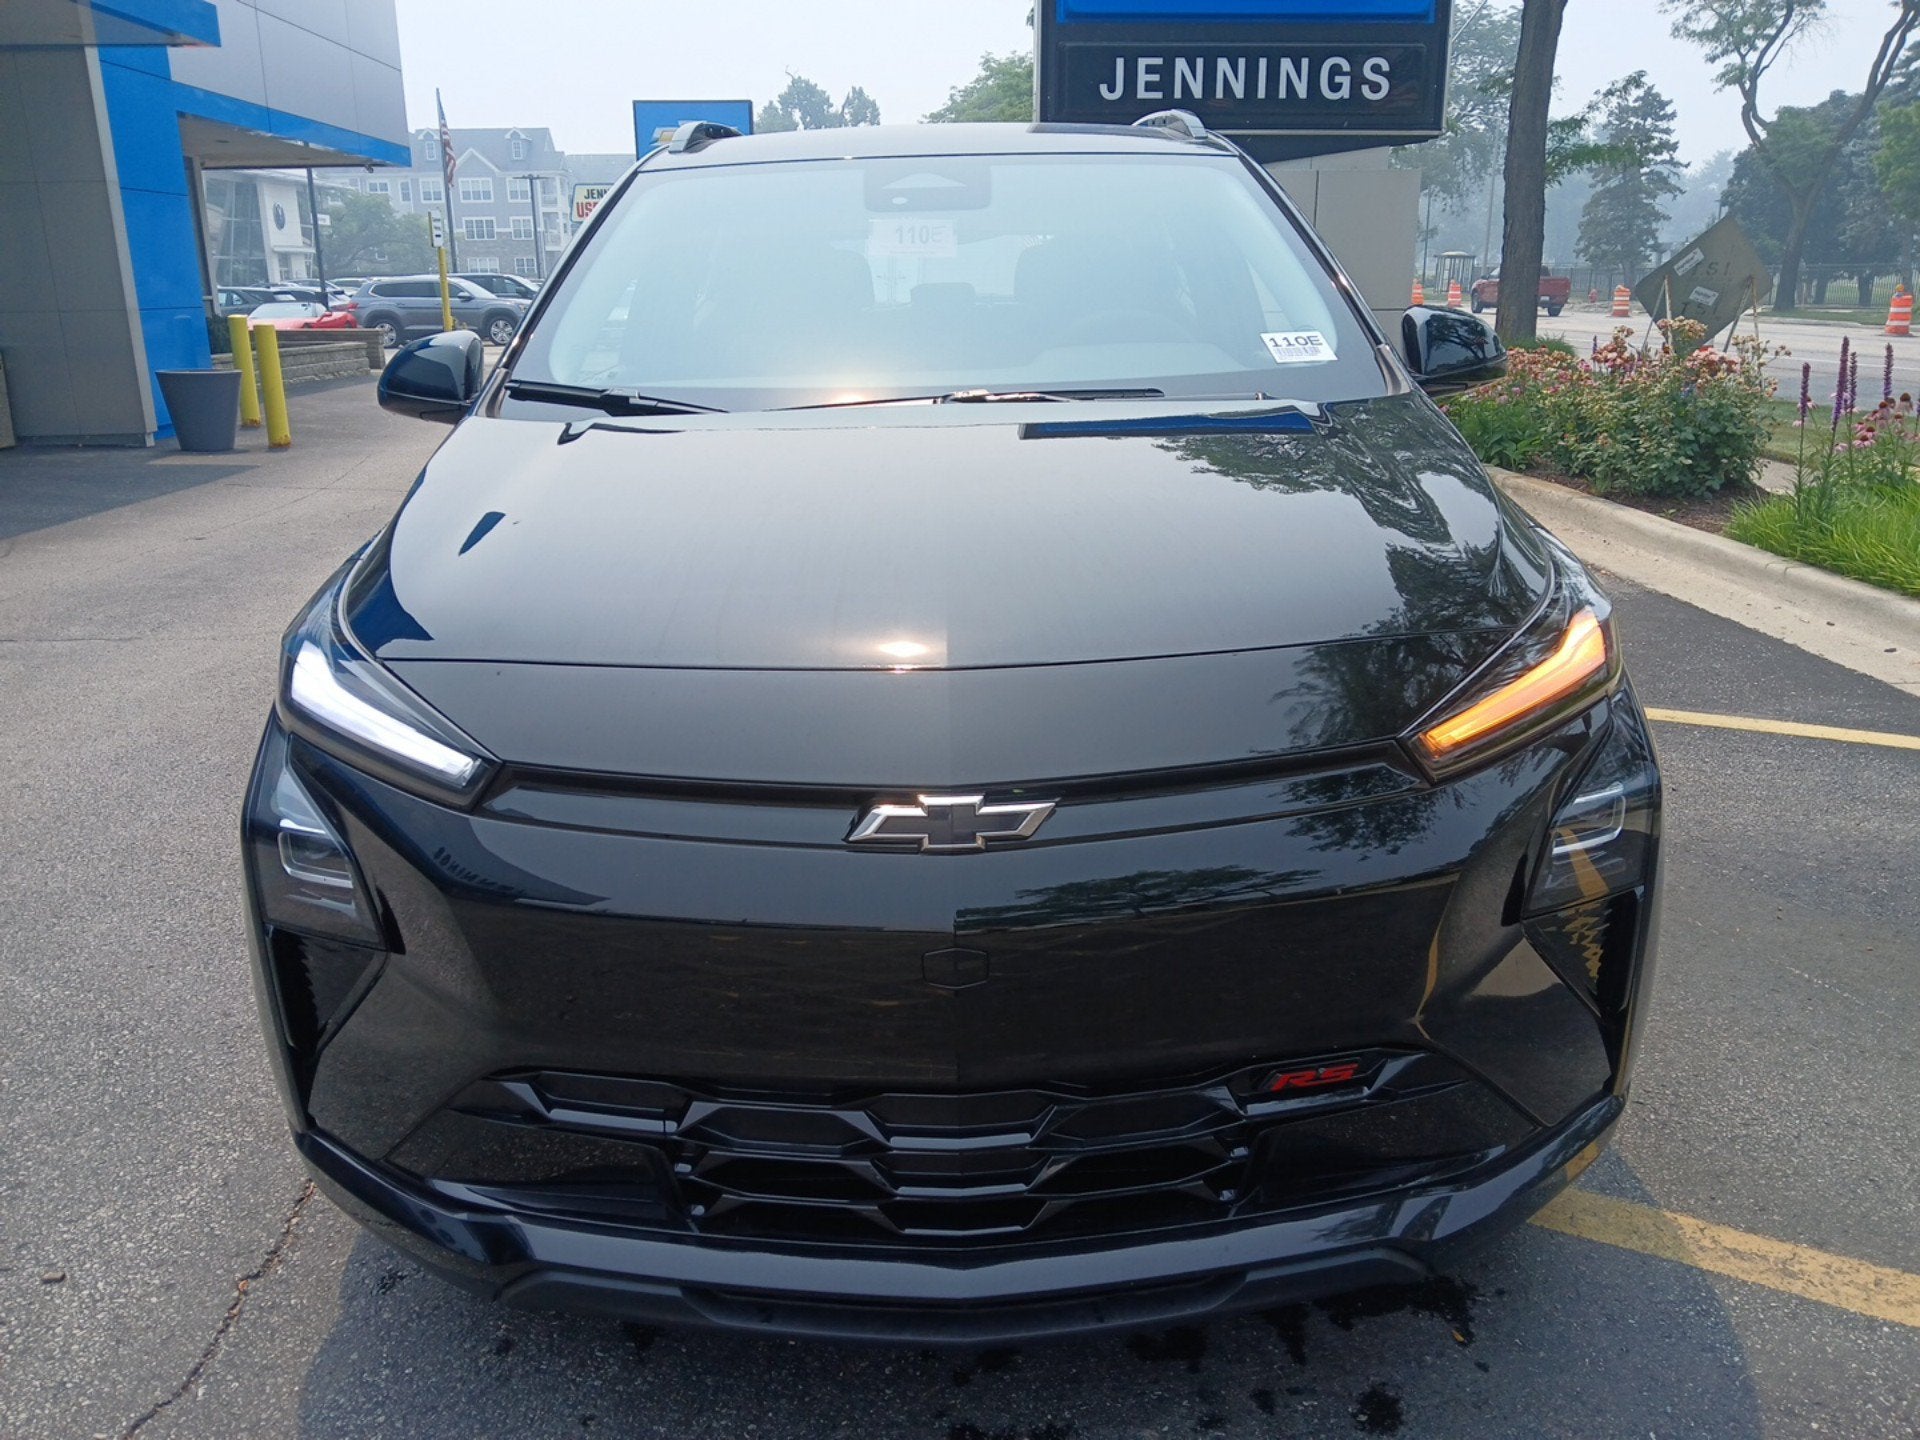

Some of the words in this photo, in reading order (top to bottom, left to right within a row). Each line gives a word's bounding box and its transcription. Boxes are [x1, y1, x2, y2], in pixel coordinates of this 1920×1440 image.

[1099, 56, 1391, 100] JENNINGS
[1269, 335, 1322, 347] 110E
[1271, 1063, 1358, 1092] RS
